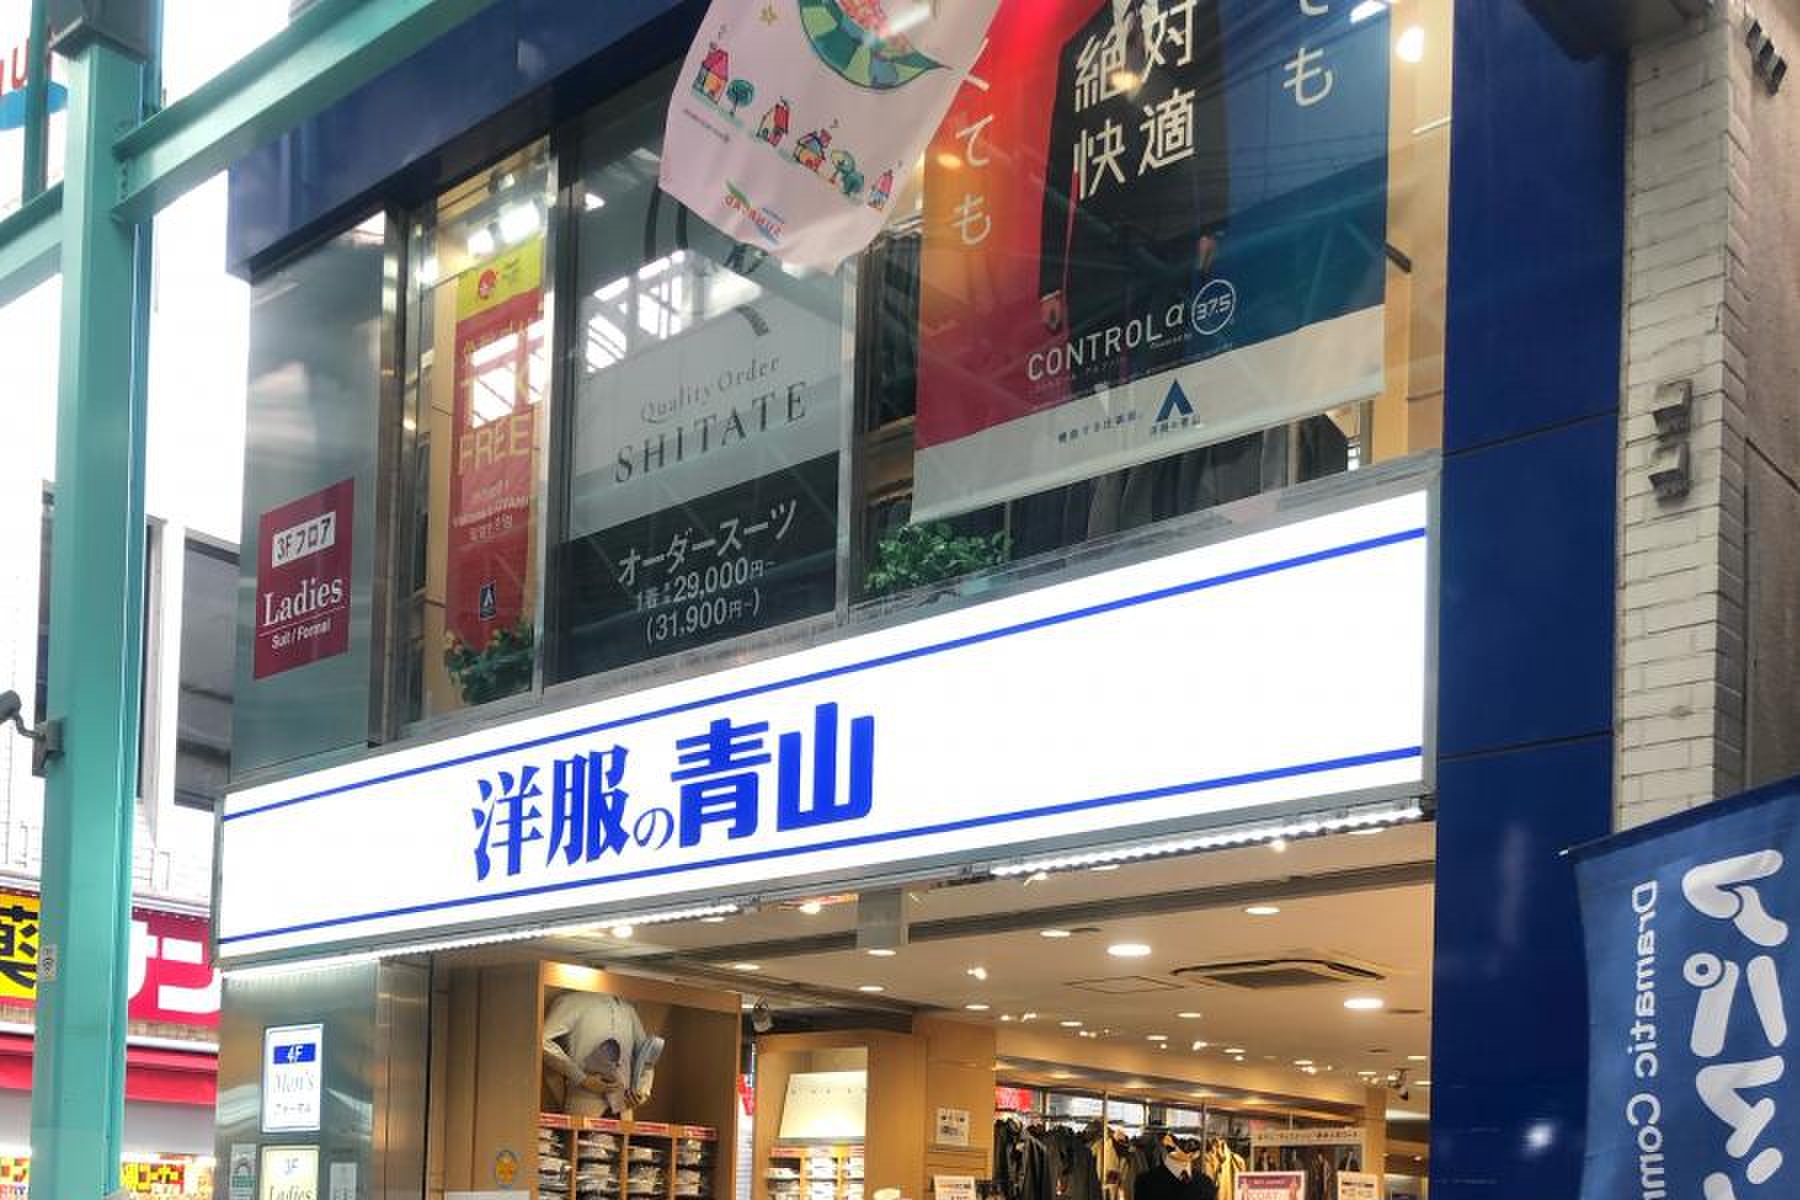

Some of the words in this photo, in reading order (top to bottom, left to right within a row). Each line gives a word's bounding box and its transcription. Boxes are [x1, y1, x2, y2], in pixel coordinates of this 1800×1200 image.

[1074, 0, 1197, 112] 絶対
[1073, 87, 1197, 200] 快適
[615, 381, 807, 483] SHITATE
[640, 384, 712, 424] Quality
[718, 357, 780, 392] Order
[617, 499, 797, 586] オーダースーツ
[263, 577, 343, 627] Ladies
[471, 701, 875, 882] 洋服の青山
[287, 1044, 303, 1064] 4F
